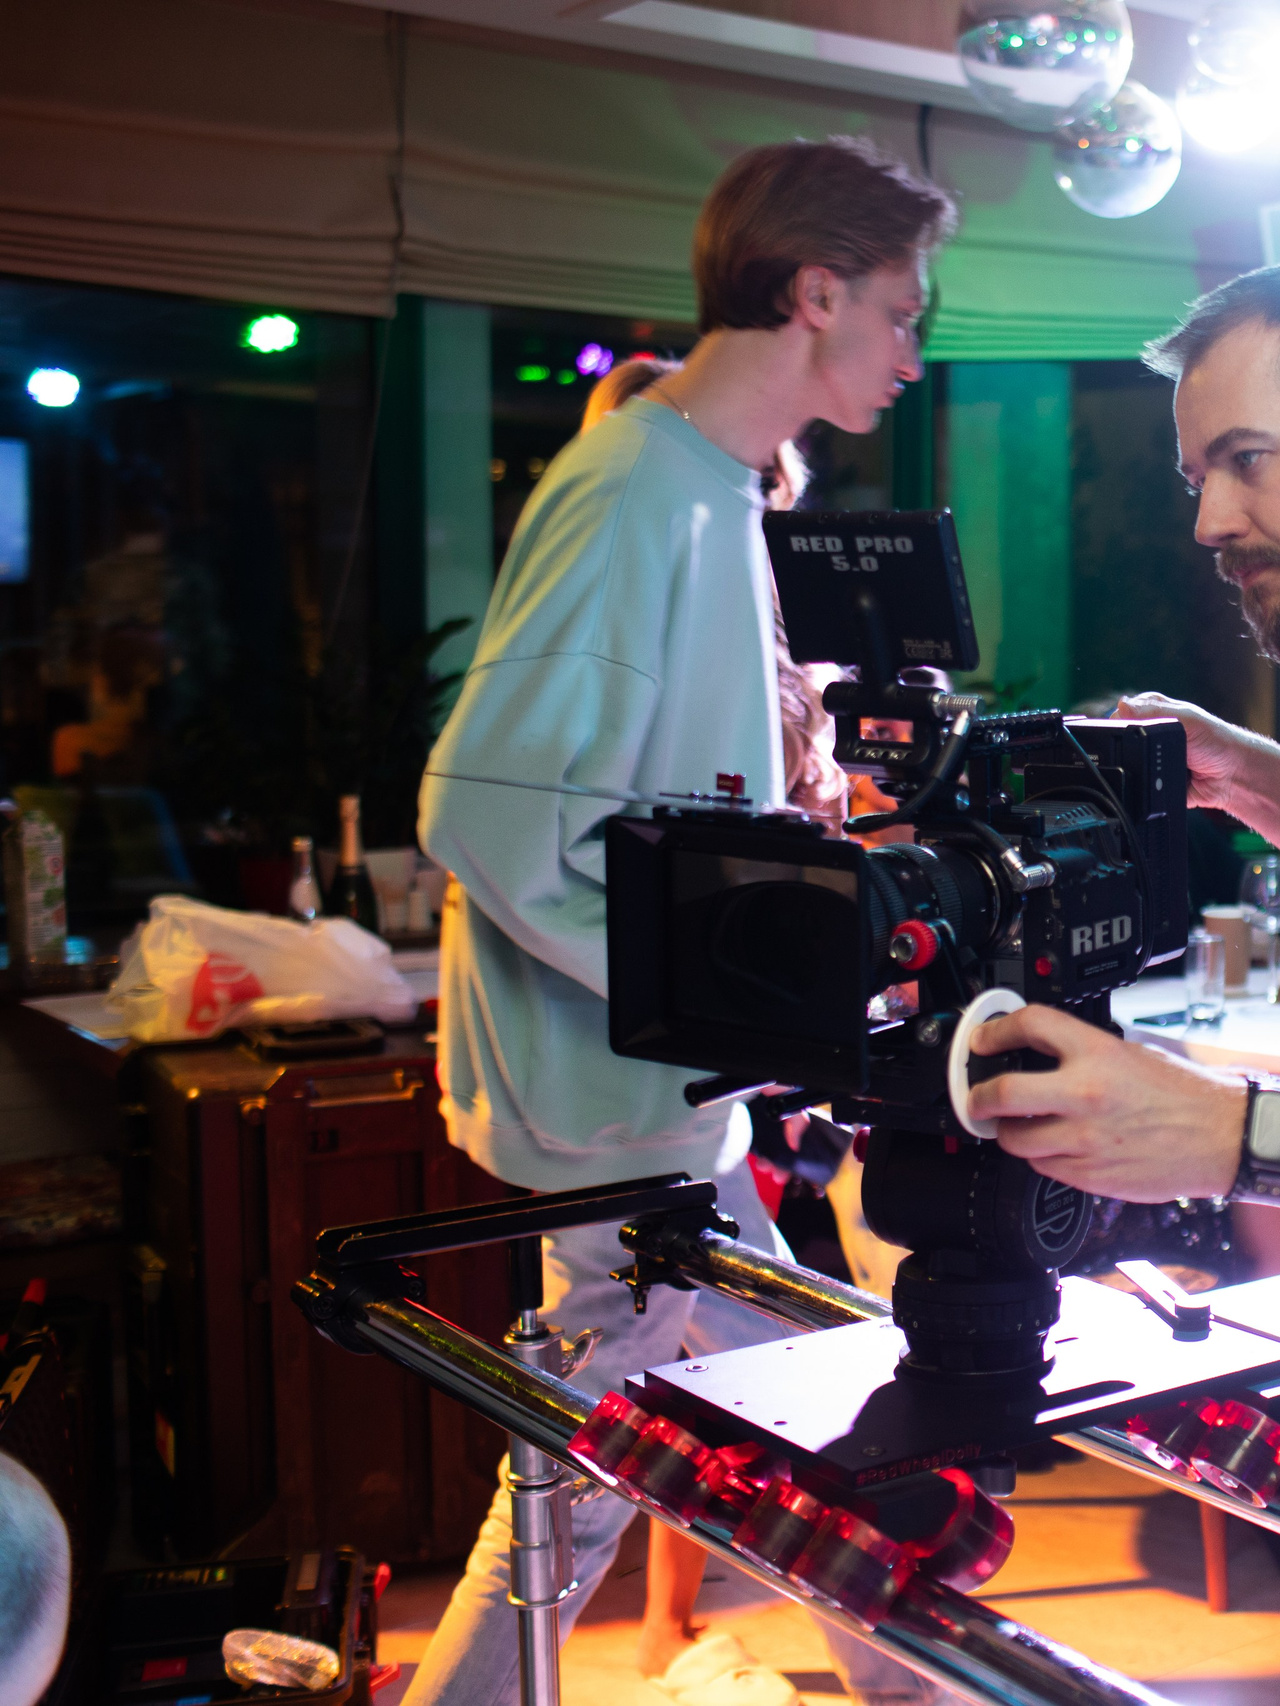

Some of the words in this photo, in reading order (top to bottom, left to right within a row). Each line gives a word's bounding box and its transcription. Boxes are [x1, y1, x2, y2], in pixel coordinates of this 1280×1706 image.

[790, 536, 844, 553] RED
[854, 536, 914, 553] PRO
[831, 556, 879, 572] 5.0
[1071, 915, 1132, 957] RED
